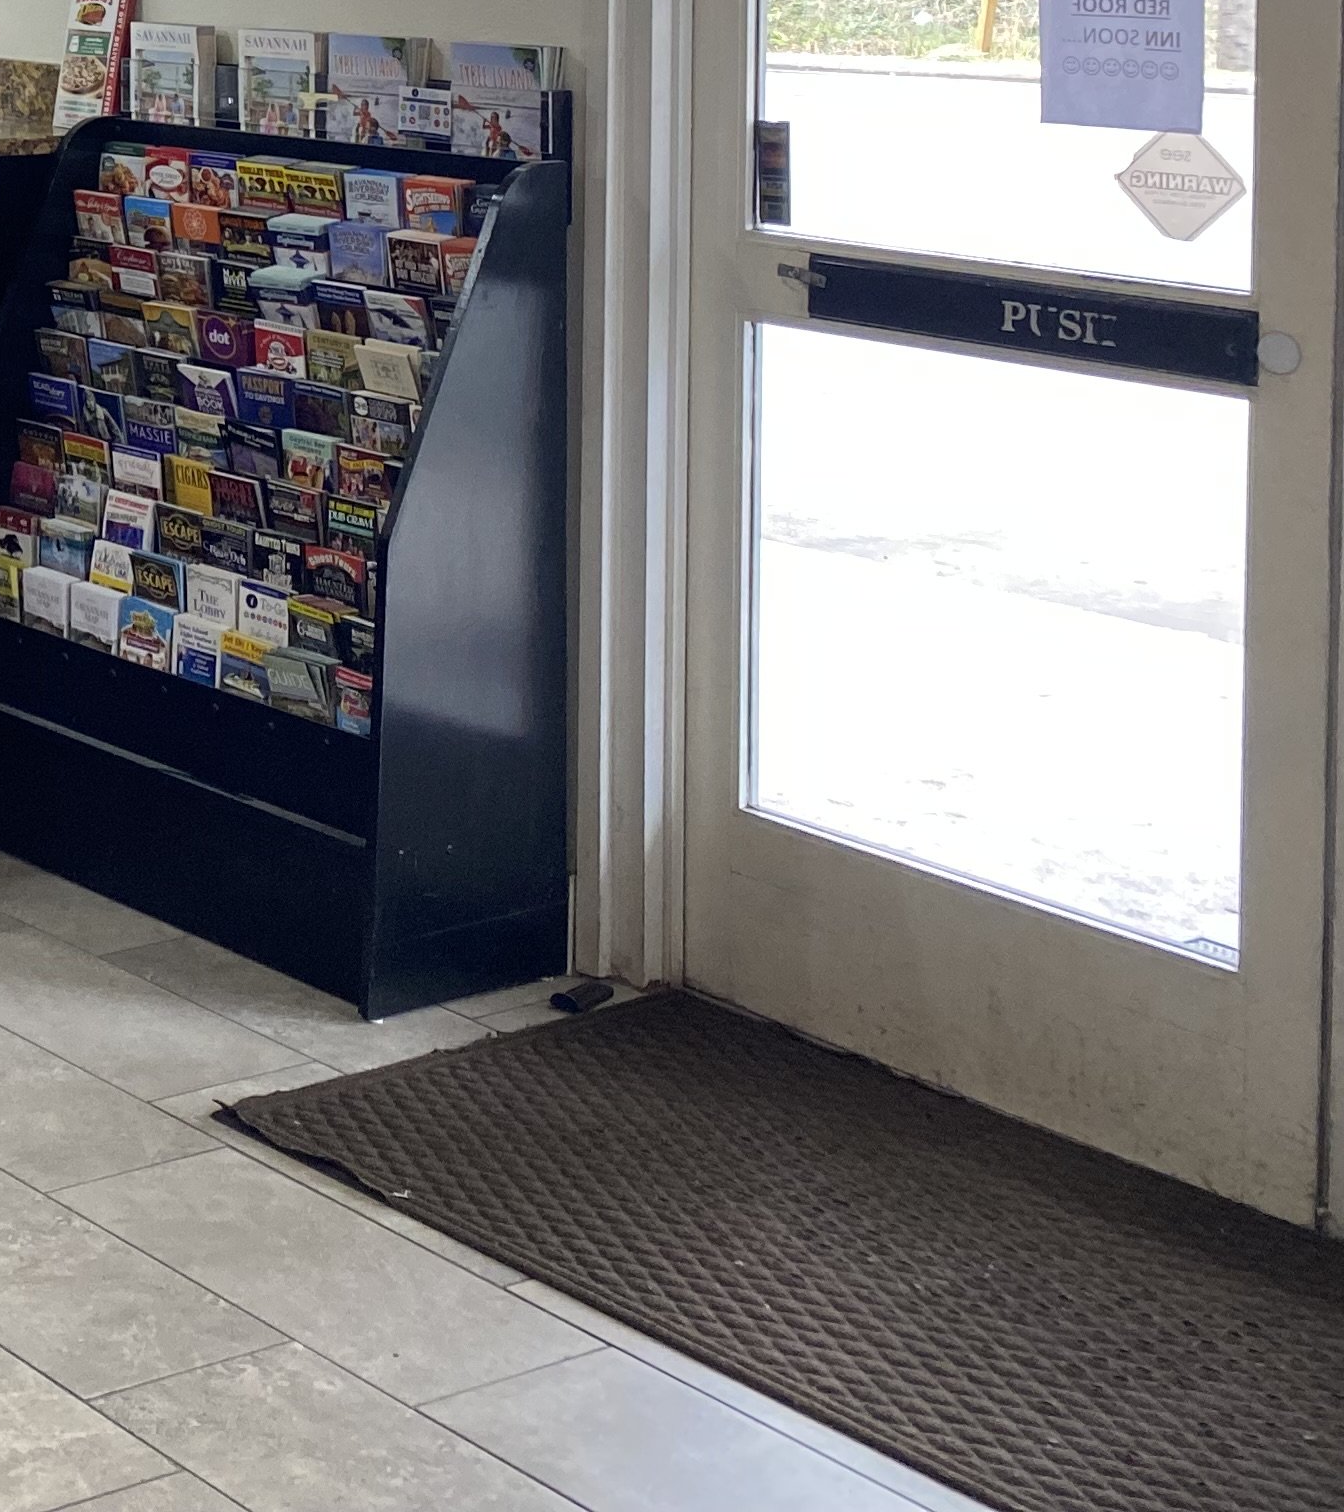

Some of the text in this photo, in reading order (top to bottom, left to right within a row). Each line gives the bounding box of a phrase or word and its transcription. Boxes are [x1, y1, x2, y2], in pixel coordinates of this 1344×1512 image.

[135, 29, 192, 45] SAVANNAH
[244, 36, 308, 51] SAVANNAH
[334, 54, 402, 79] TYBEE ISLAND
[459, 63, 535, 90] TYBEE ISLAND
[208, 329, 231, 345] dot
[241, 375, 285, 397] PASSPORT
[128, 422, 172, 445] MASSIE
[175, 463, 209, 490] CIGARS
[163, 520, 200, 543] ESCAPE
[346, 512, 374, 529] CRAWL
[137, 569, 174, 593] ESCAPE
[199, 588, 218, 603] THE
[193, 598, 226, 620] LOBBY
[267, 667, 312, 688] GUIDE
